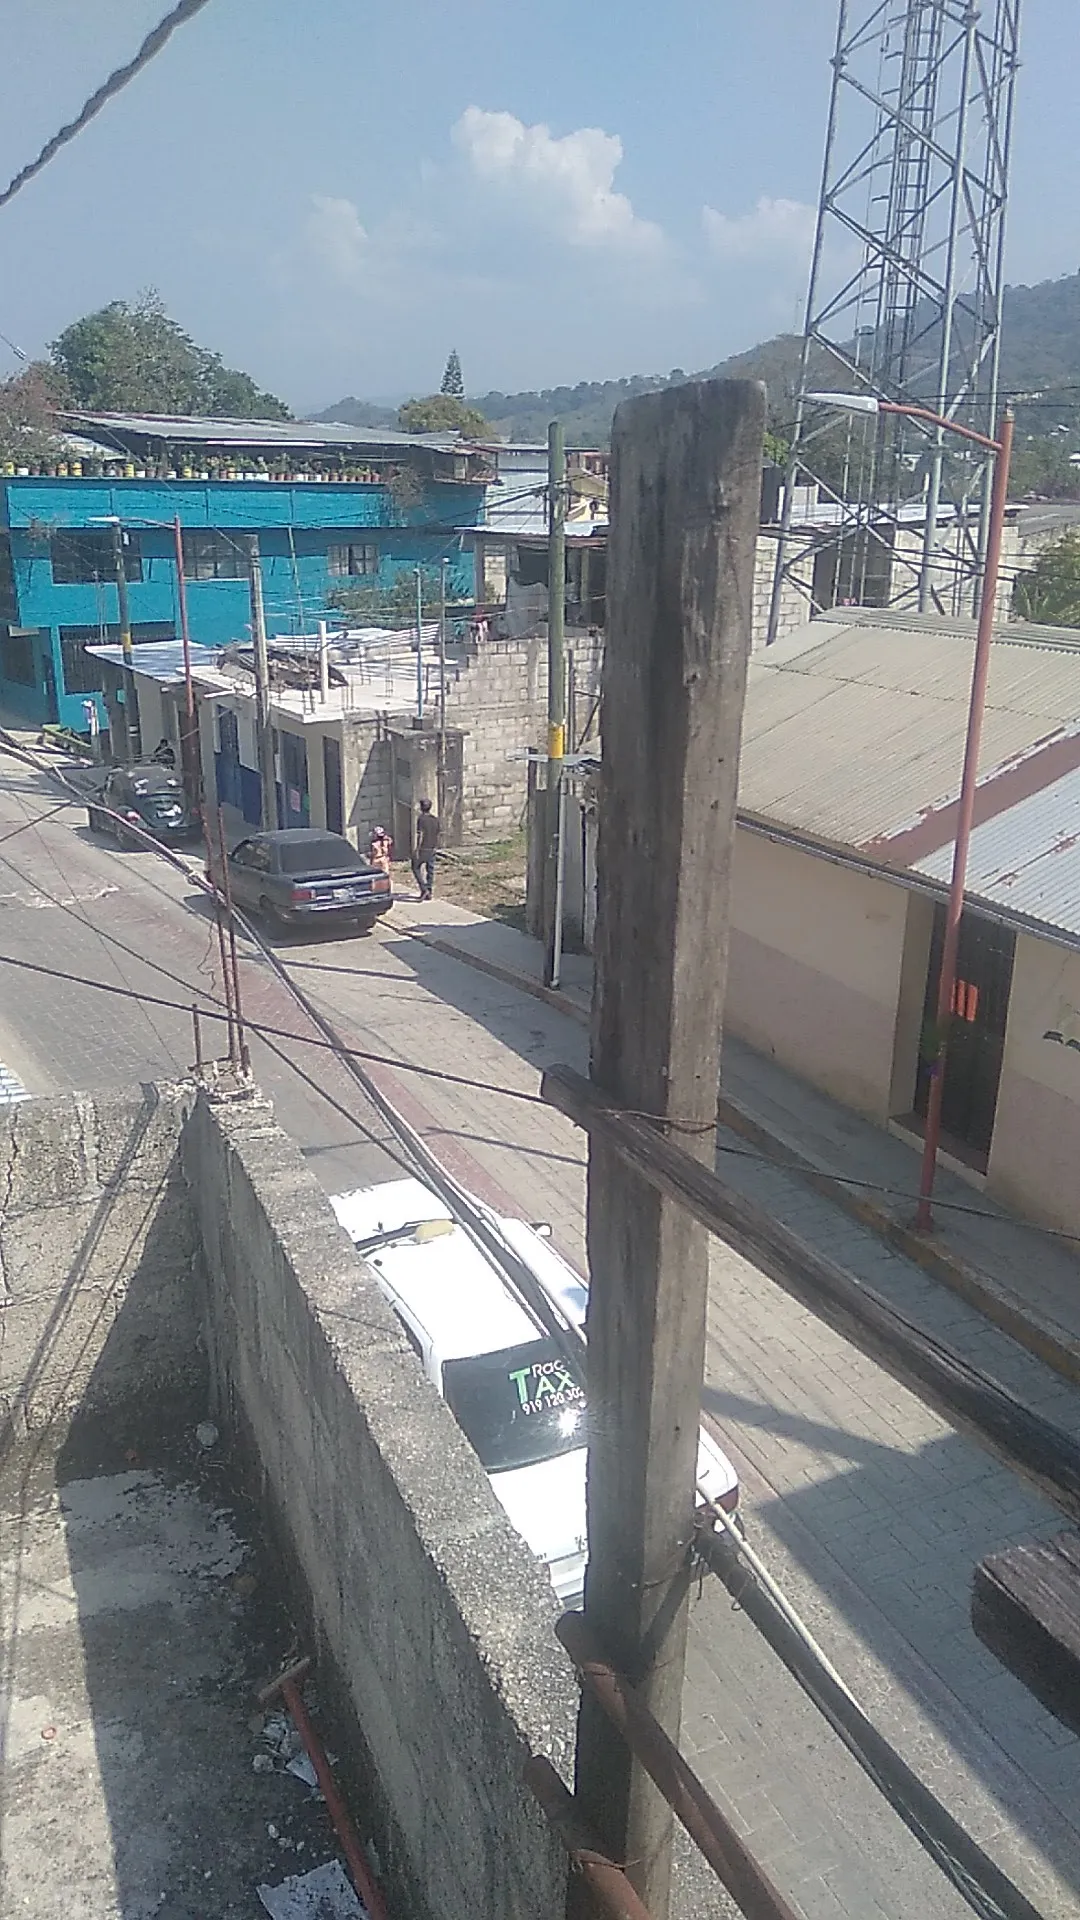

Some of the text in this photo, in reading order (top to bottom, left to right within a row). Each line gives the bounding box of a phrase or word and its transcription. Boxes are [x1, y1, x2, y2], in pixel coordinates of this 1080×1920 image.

[509, 1368, 575, 1404] TAX
[522, 1398, 542, 1415] 919
[544, 1392, 564, 1407] 120
